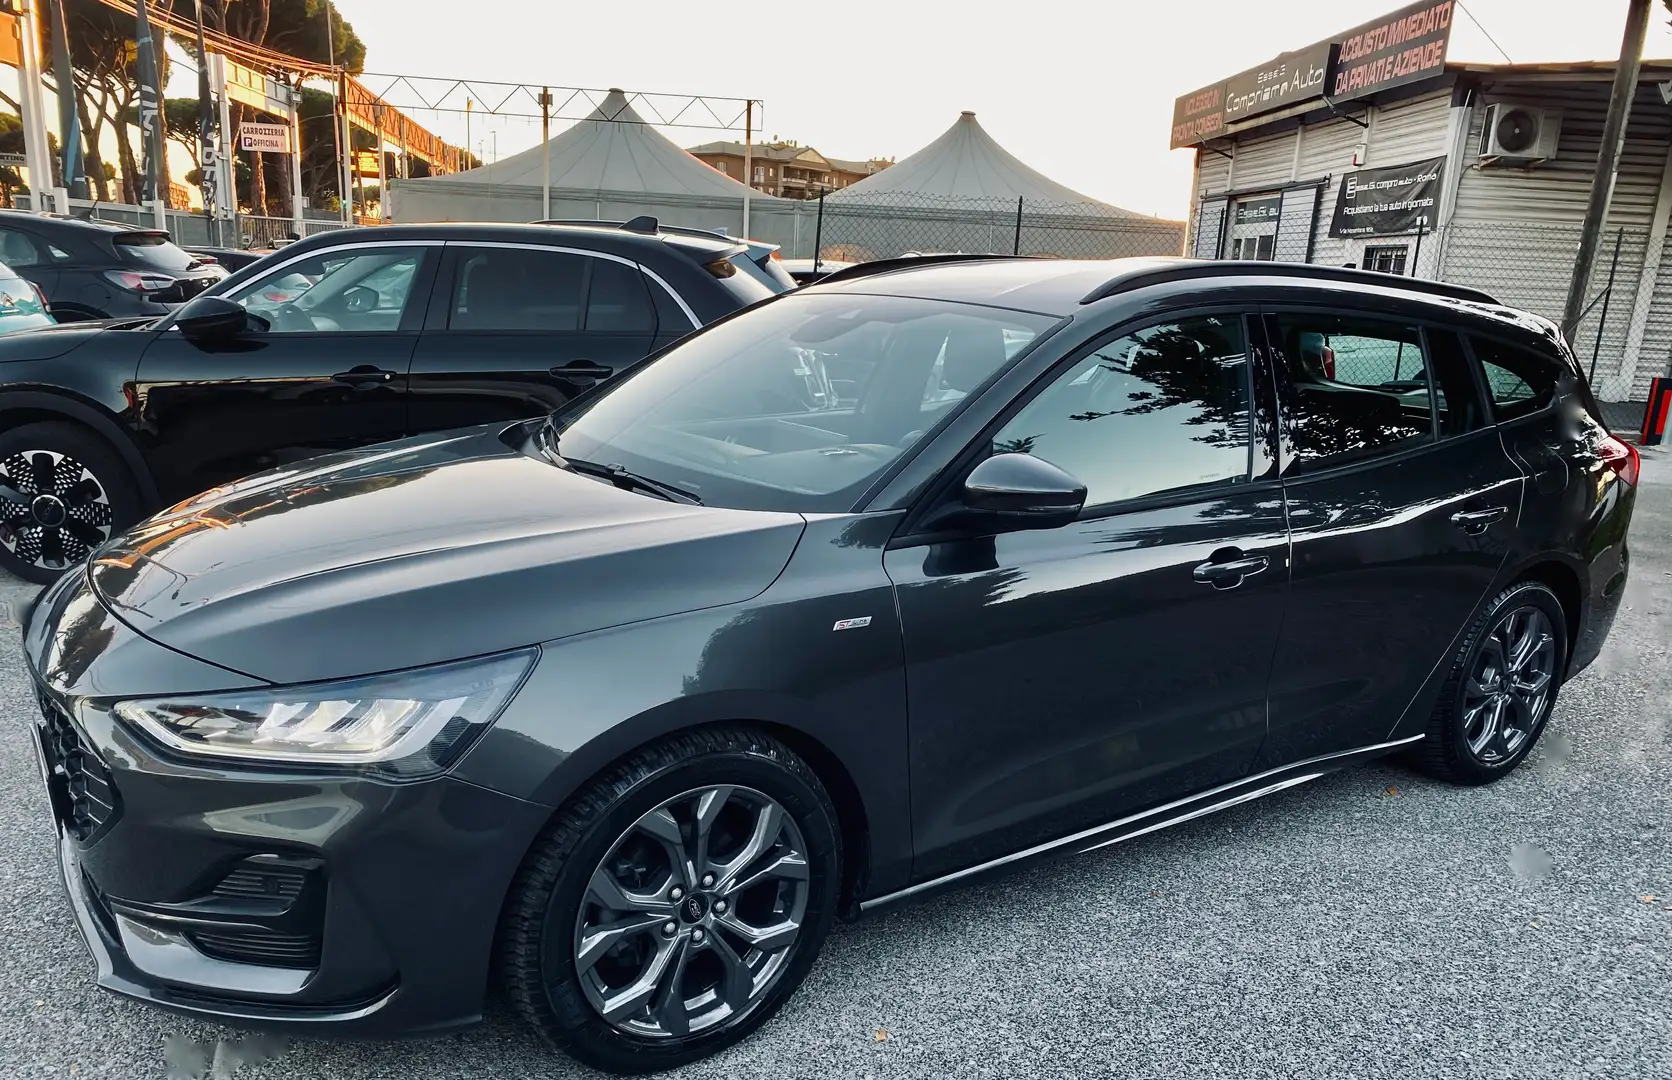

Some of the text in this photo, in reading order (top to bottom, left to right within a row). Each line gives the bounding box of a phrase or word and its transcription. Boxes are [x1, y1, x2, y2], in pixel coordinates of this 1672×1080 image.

[1338, 1, 1452, 64] ACQUISTO IMMEDIATO
[1334, 40, 1444, 96] DA PRIVATI E AZIENDE
[1290, 64, 1324, 93] Auto
[242, 127, 285, 136] CARROZZERIA
[253, 139, 279, 148] OFFICINA
[1377, 180, 1398, 191] compro
[1417, 173, 1437, 183] Roma
[1407, 197, 1434, 210] giornata
